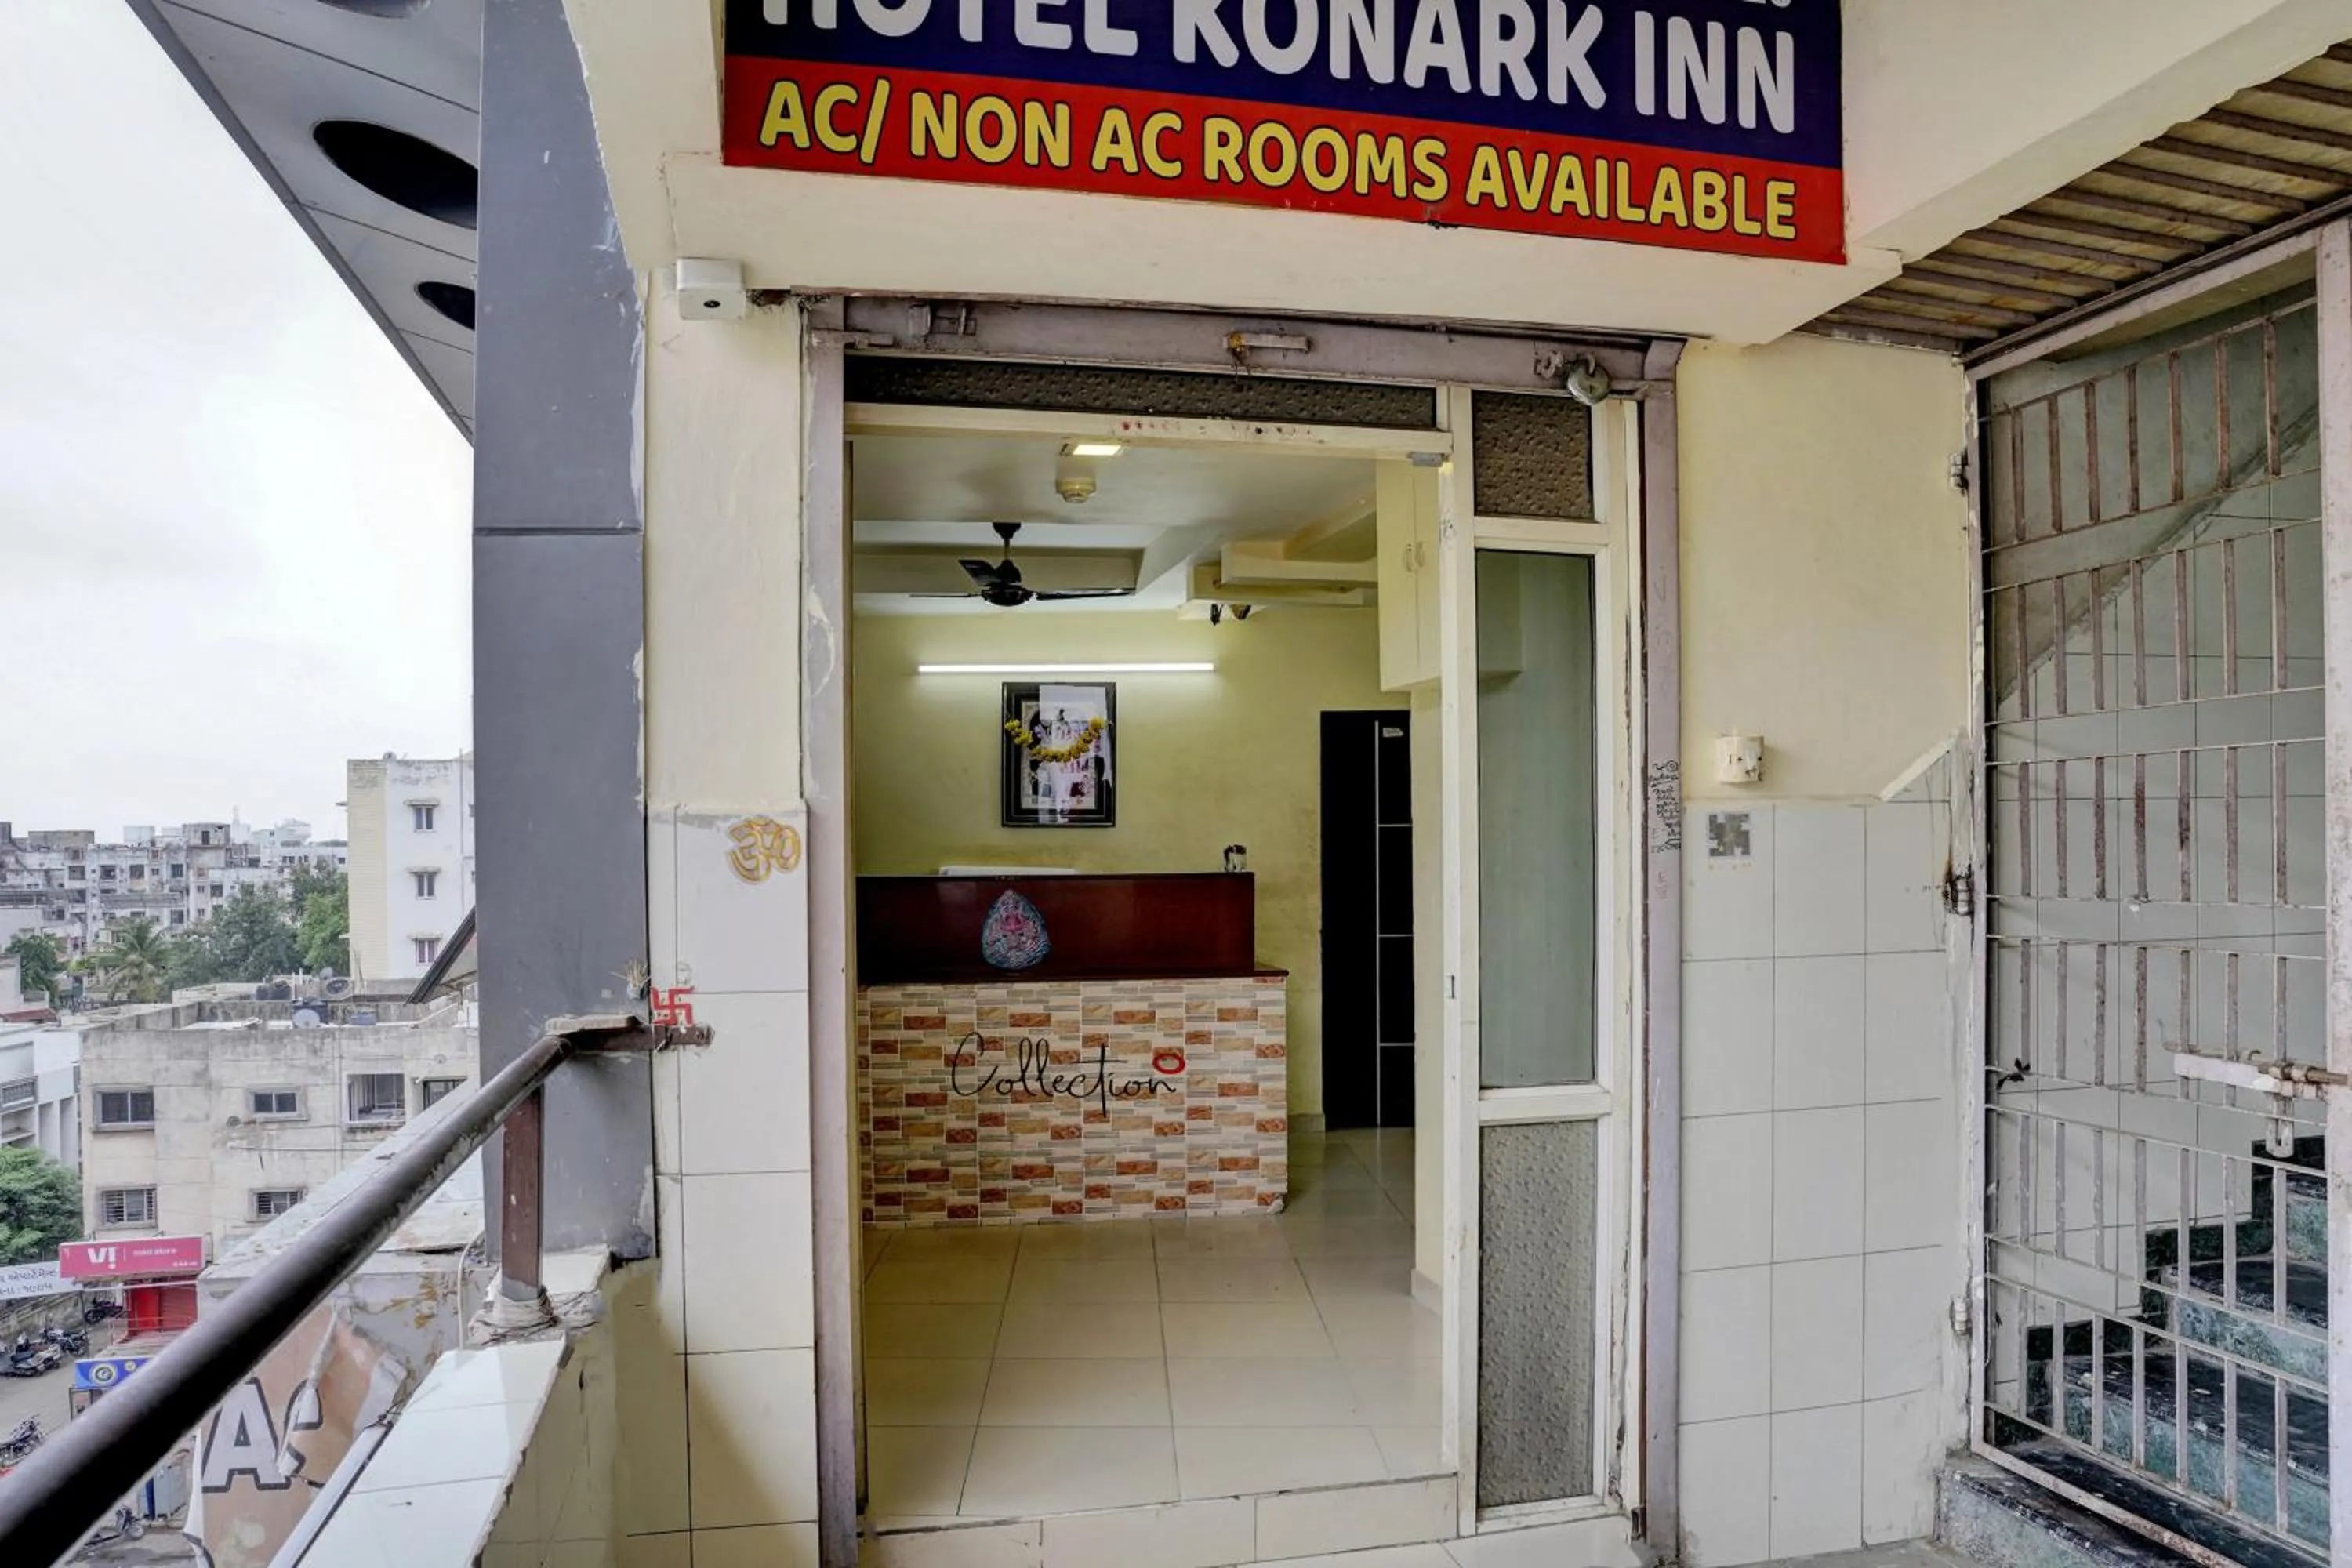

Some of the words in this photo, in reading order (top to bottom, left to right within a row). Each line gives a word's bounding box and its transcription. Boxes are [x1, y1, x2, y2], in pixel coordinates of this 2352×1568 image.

[1173, 0, 1606, 109] KONARK
[1635, 10, 1795, 134] INN
[760, 78, 891, 165] AC/
[909, 90, 1071, 169] NON
[1090, 107, 1183, 179] AC
[1203, 115, 1450, 202] ROOMS
[1464, 144, 1797, 241] AVAILABLE
[952, 1032, 1177, 1118] Collection
